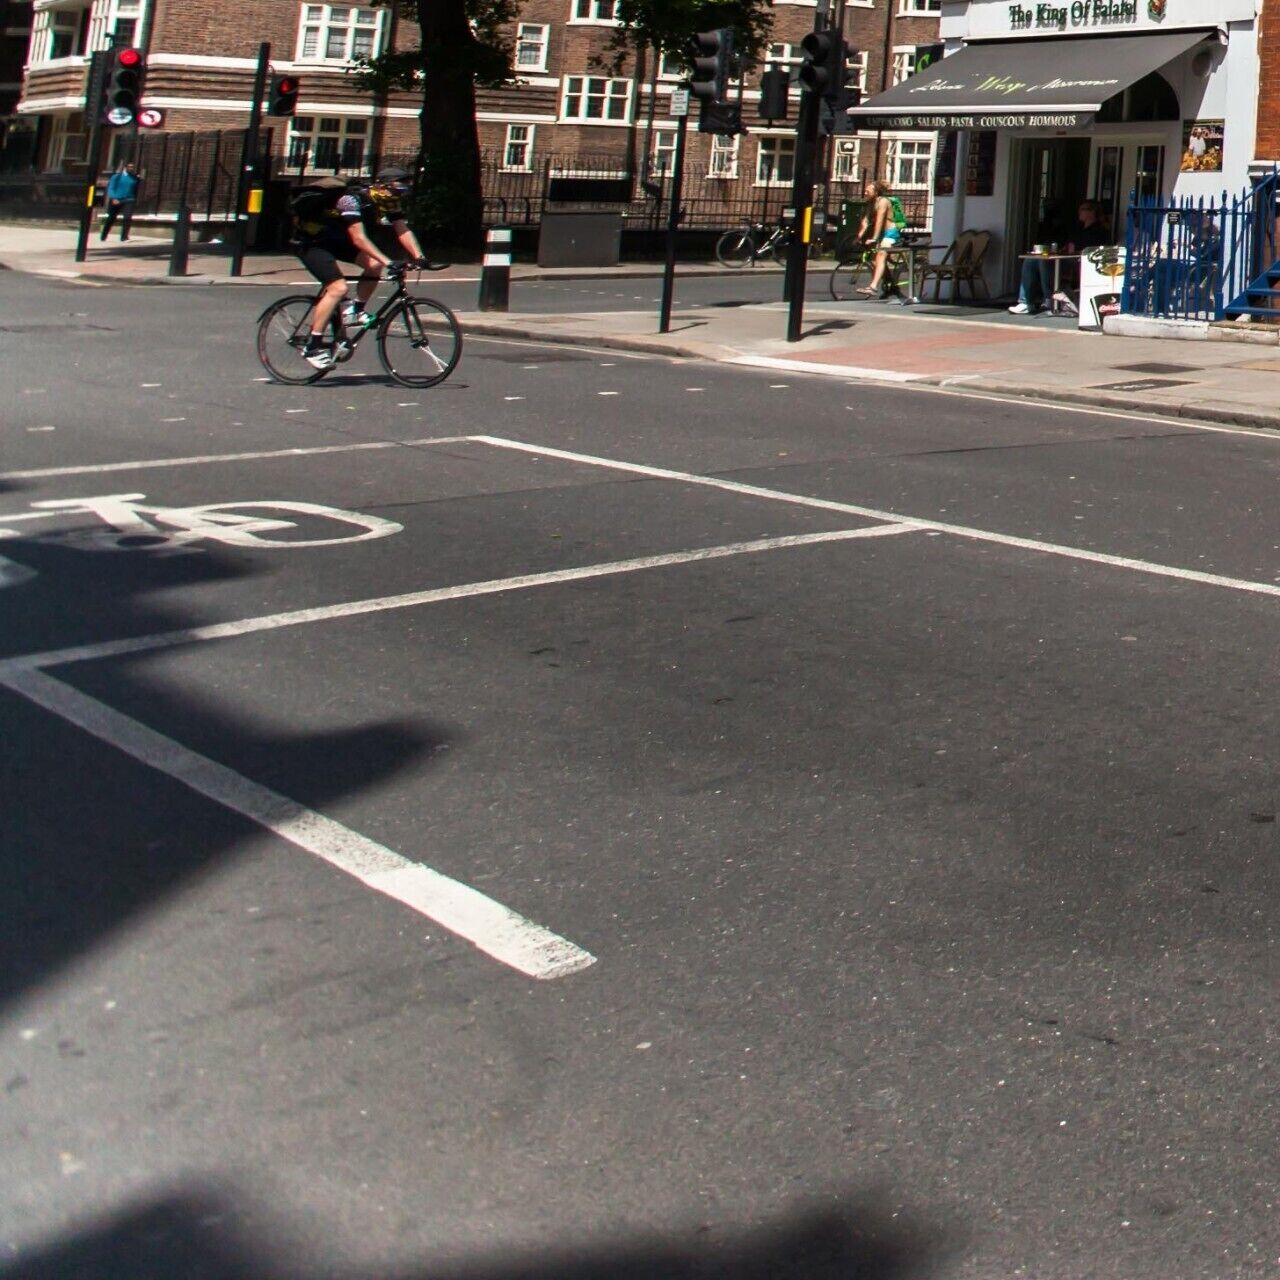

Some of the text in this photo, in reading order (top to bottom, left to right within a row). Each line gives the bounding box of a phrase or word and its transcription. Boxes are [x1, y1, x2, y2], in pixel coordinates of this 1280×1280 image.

[1009, 3, 1033, 23] The
[1036, 3, 1067, 26] King
[1071, 0, 1091, 20] Of
[917, 116, 946, 127] SALADS
[951, 116, 974, 127] PASTA
[980, 115, 1025, 127] COUSCOUS
[1028, 114, 1076, 126] HOMMOUS
